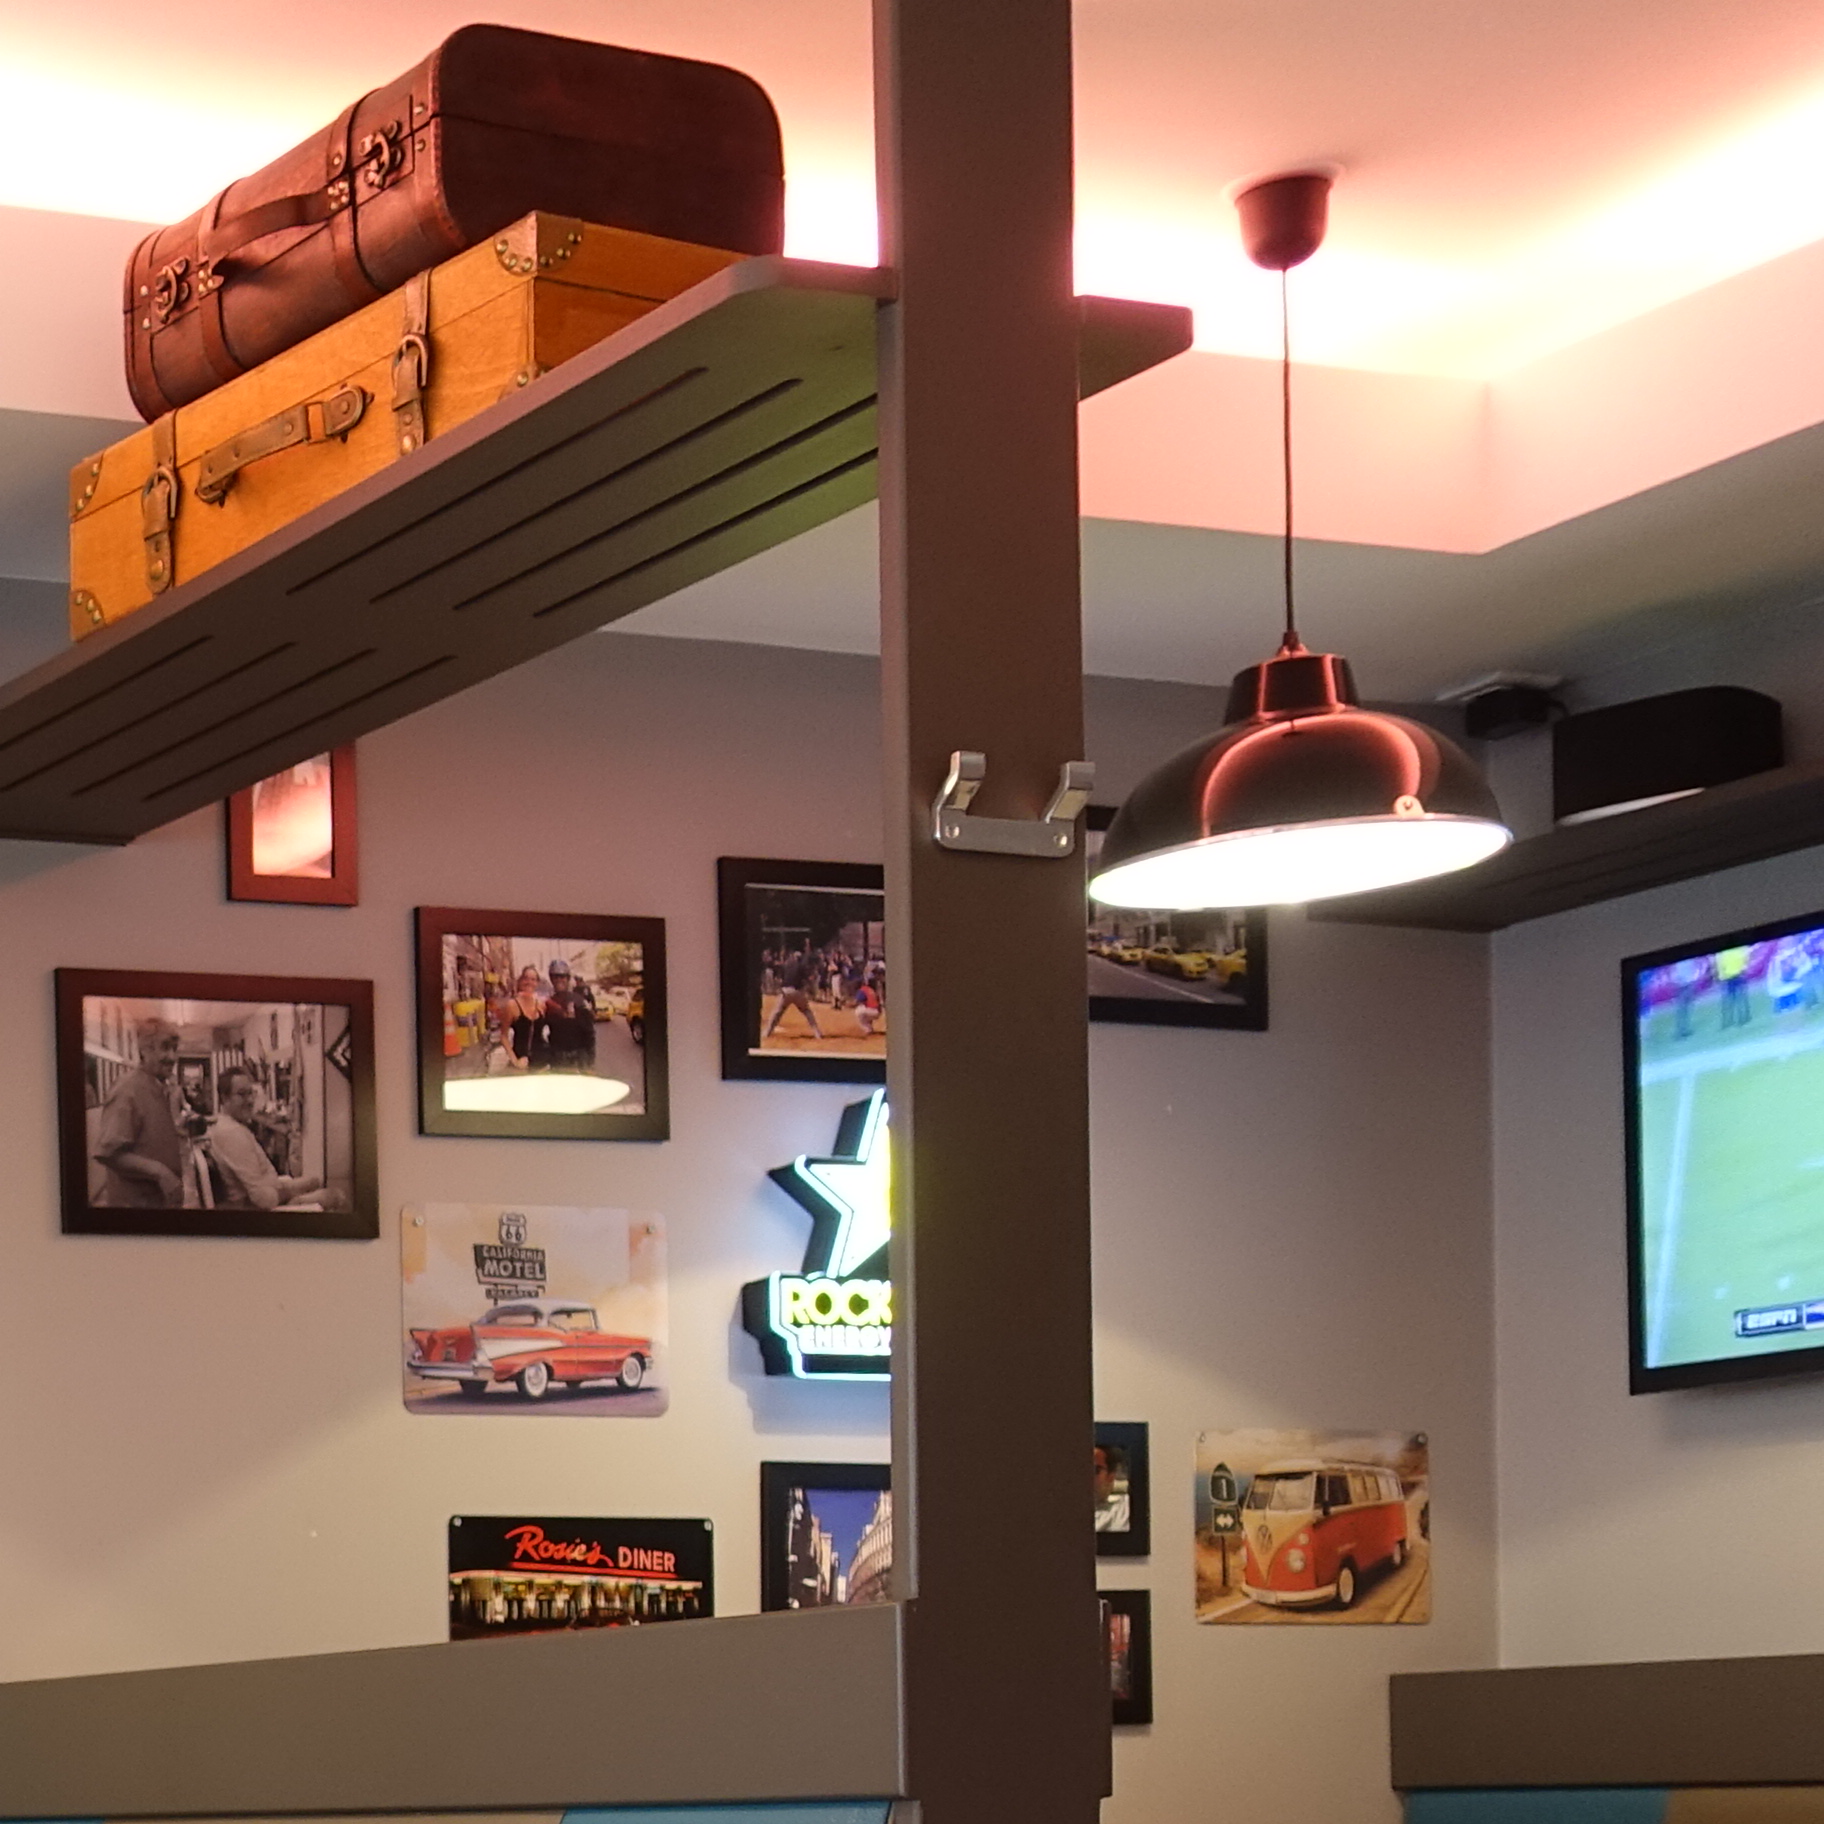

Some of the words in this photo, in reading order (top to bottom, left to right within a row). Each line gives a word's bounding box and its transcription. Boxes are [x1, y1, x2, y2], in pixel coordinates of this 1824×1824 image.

[506, 1225, 521, 1241] 66
[482, 1246, 545, 1260] CALIFORNIA
[484, 1259, 544, 1279] MOTEL
[618, 1546, 675, 1572] DINER
